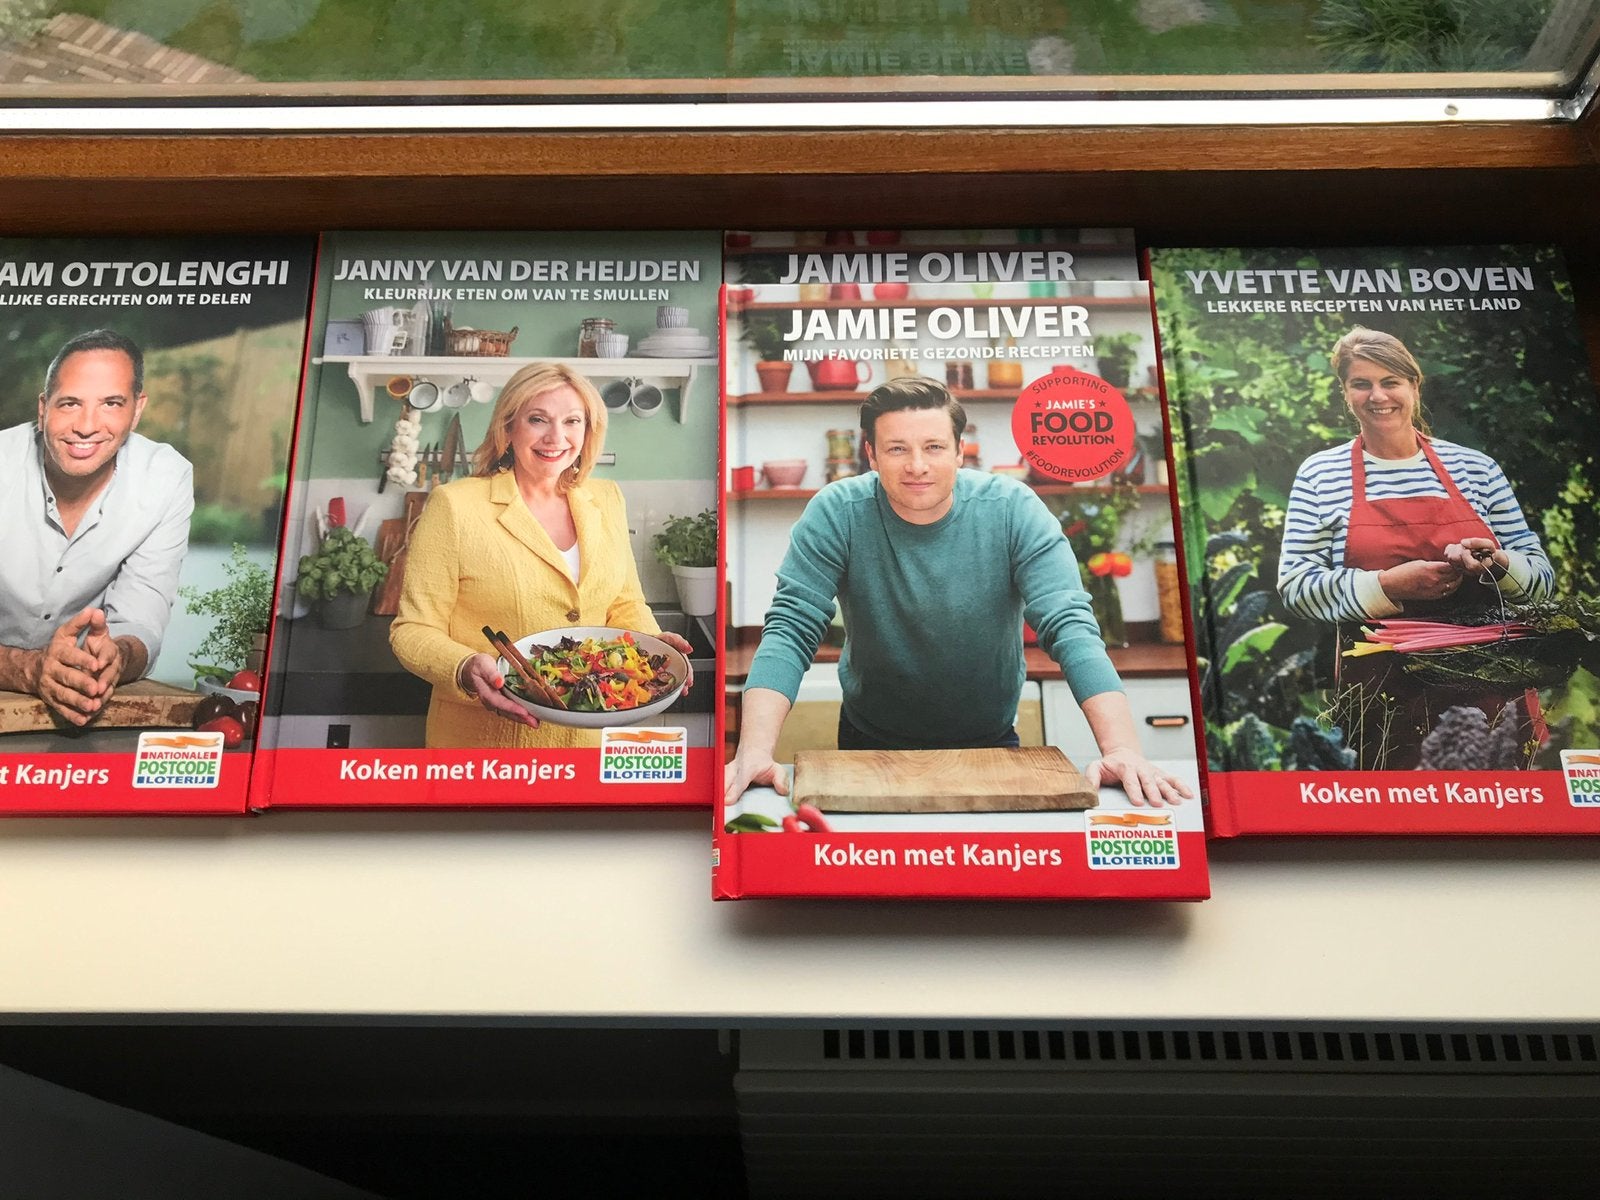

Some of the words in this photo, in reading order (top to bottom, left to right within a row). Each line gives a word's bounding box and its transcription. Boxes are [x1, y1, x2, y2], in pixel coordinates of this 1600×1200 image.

[61, 260, 289, 287] OTTOLENGHI
[334, 260, 435, 281] JANNY
[440, 260, 503, 281] VAN
[510, 260, 569, 282] DER
[575, 260, 700, 282] HEIJDEN
[780, 253, 909, 283] JAMIE
[918, 251, 1077, 282] OLIVER
[1184, 269, 1321, 294] YVETTE
[1323, 268, 1402, 293] VAN
[1408, 266, 1535, 292] BOVEN
[46, 294, 143, 306] GERECHTEN
[146, 293, 173, 305] OM
[177, 293, 195, 305] TE
[199, 293, 252, 305] DELEN
[364, 288, 453, 301] KLEURRIJK
[456, 288, 497, 301] ETEN
[501, 288, 528, 301] OM
[532, 288, 566, 301] VAN
[570, 288, 589, 301] TE
[593, 288, 669, 301] SMULLEN
[1207, 299, 1287, 313] LEKKERE
[1292, 299, 1383, 312] RECEPTEN
[1386, 299, 1426, 312] VAN
[1429, 298, 1466, 311] HET
[1470, 297, 1522, 310] LAND
[783, 307, 918, 341] JAMIE
[927, 305, 1092, 340] OLIVER
[783, 348, 824, 361] MIJN
[828, 347, 919, 361] FAVORIETE
[923, 346, 1005, 359] GEZONDE
[1009, 345, 1095, 358] RECEPTEN
[1032, 376, 1108, 394] SUPPORTING
[1045, 399, 1096, 410] JAMIE'S
[1030, 411, 1113, 433] FOOD
[1032, 434, 1115, 446] REVOLUTION
[1025, 448, 1125, 478] #FOODREVOLUTION
[149, 751, 210, 760] NATIONALE
[612, 746, 675, 755] NATIONALE
[138, 761, 217, 775] POSTCODE
[604, 756, 683, 770] POSTCODE
[15, 764, 109, 790] Kanjers
[145, 776, 208, 784] LOTERIJ
[339, 759, 418, 781] Koken
[425, 761, 475, 781] met
[481, 759, 576, 785] Kanjers
[612, 770, 674, 779] LOTERIJ
[1299, 782, 1380, 804] Koken
[1386, 784, 1439, 803] met
[1445, 782, 1544, 809] Kanjers
[1099, 830, 1165, 839] NATIONALE
[1090, 840, 1175, 855] POSTCODE
[813, 843, 896, 867] Koken
[904, 845, 956, 867] met
[963, 843, 1063, 872] Kanjers
[1100, 856, 1167, 865] LOTERIJ
